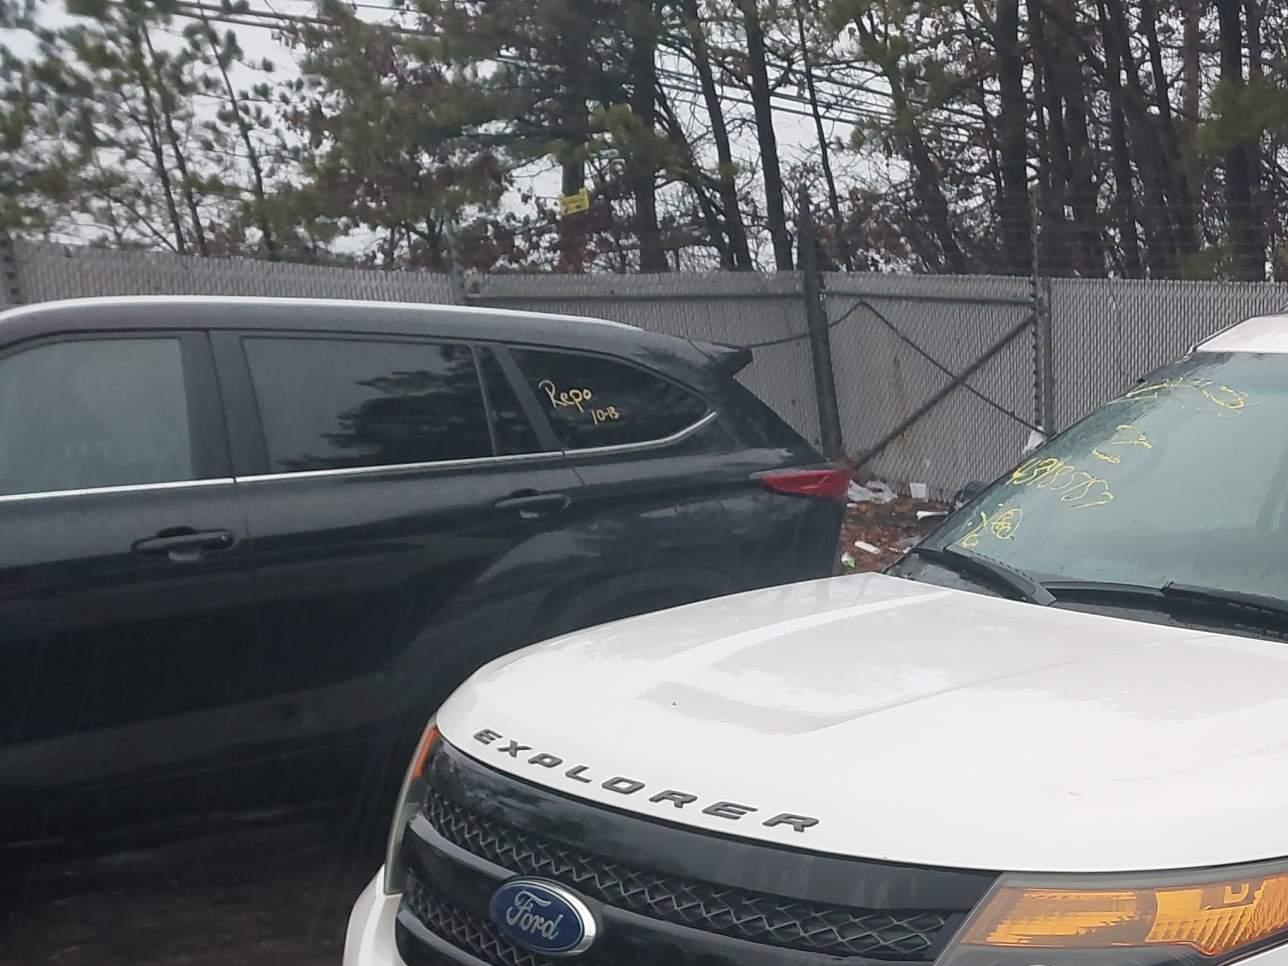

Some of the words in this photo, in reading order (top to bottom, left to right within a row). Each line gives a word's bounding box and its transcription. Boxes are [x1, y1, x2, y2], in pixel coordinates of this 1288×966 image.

[538, 380, 592, 413] Repo
[474, 728, 820, 832] EXPLORER
[506, 890, 564, 940] Ford
